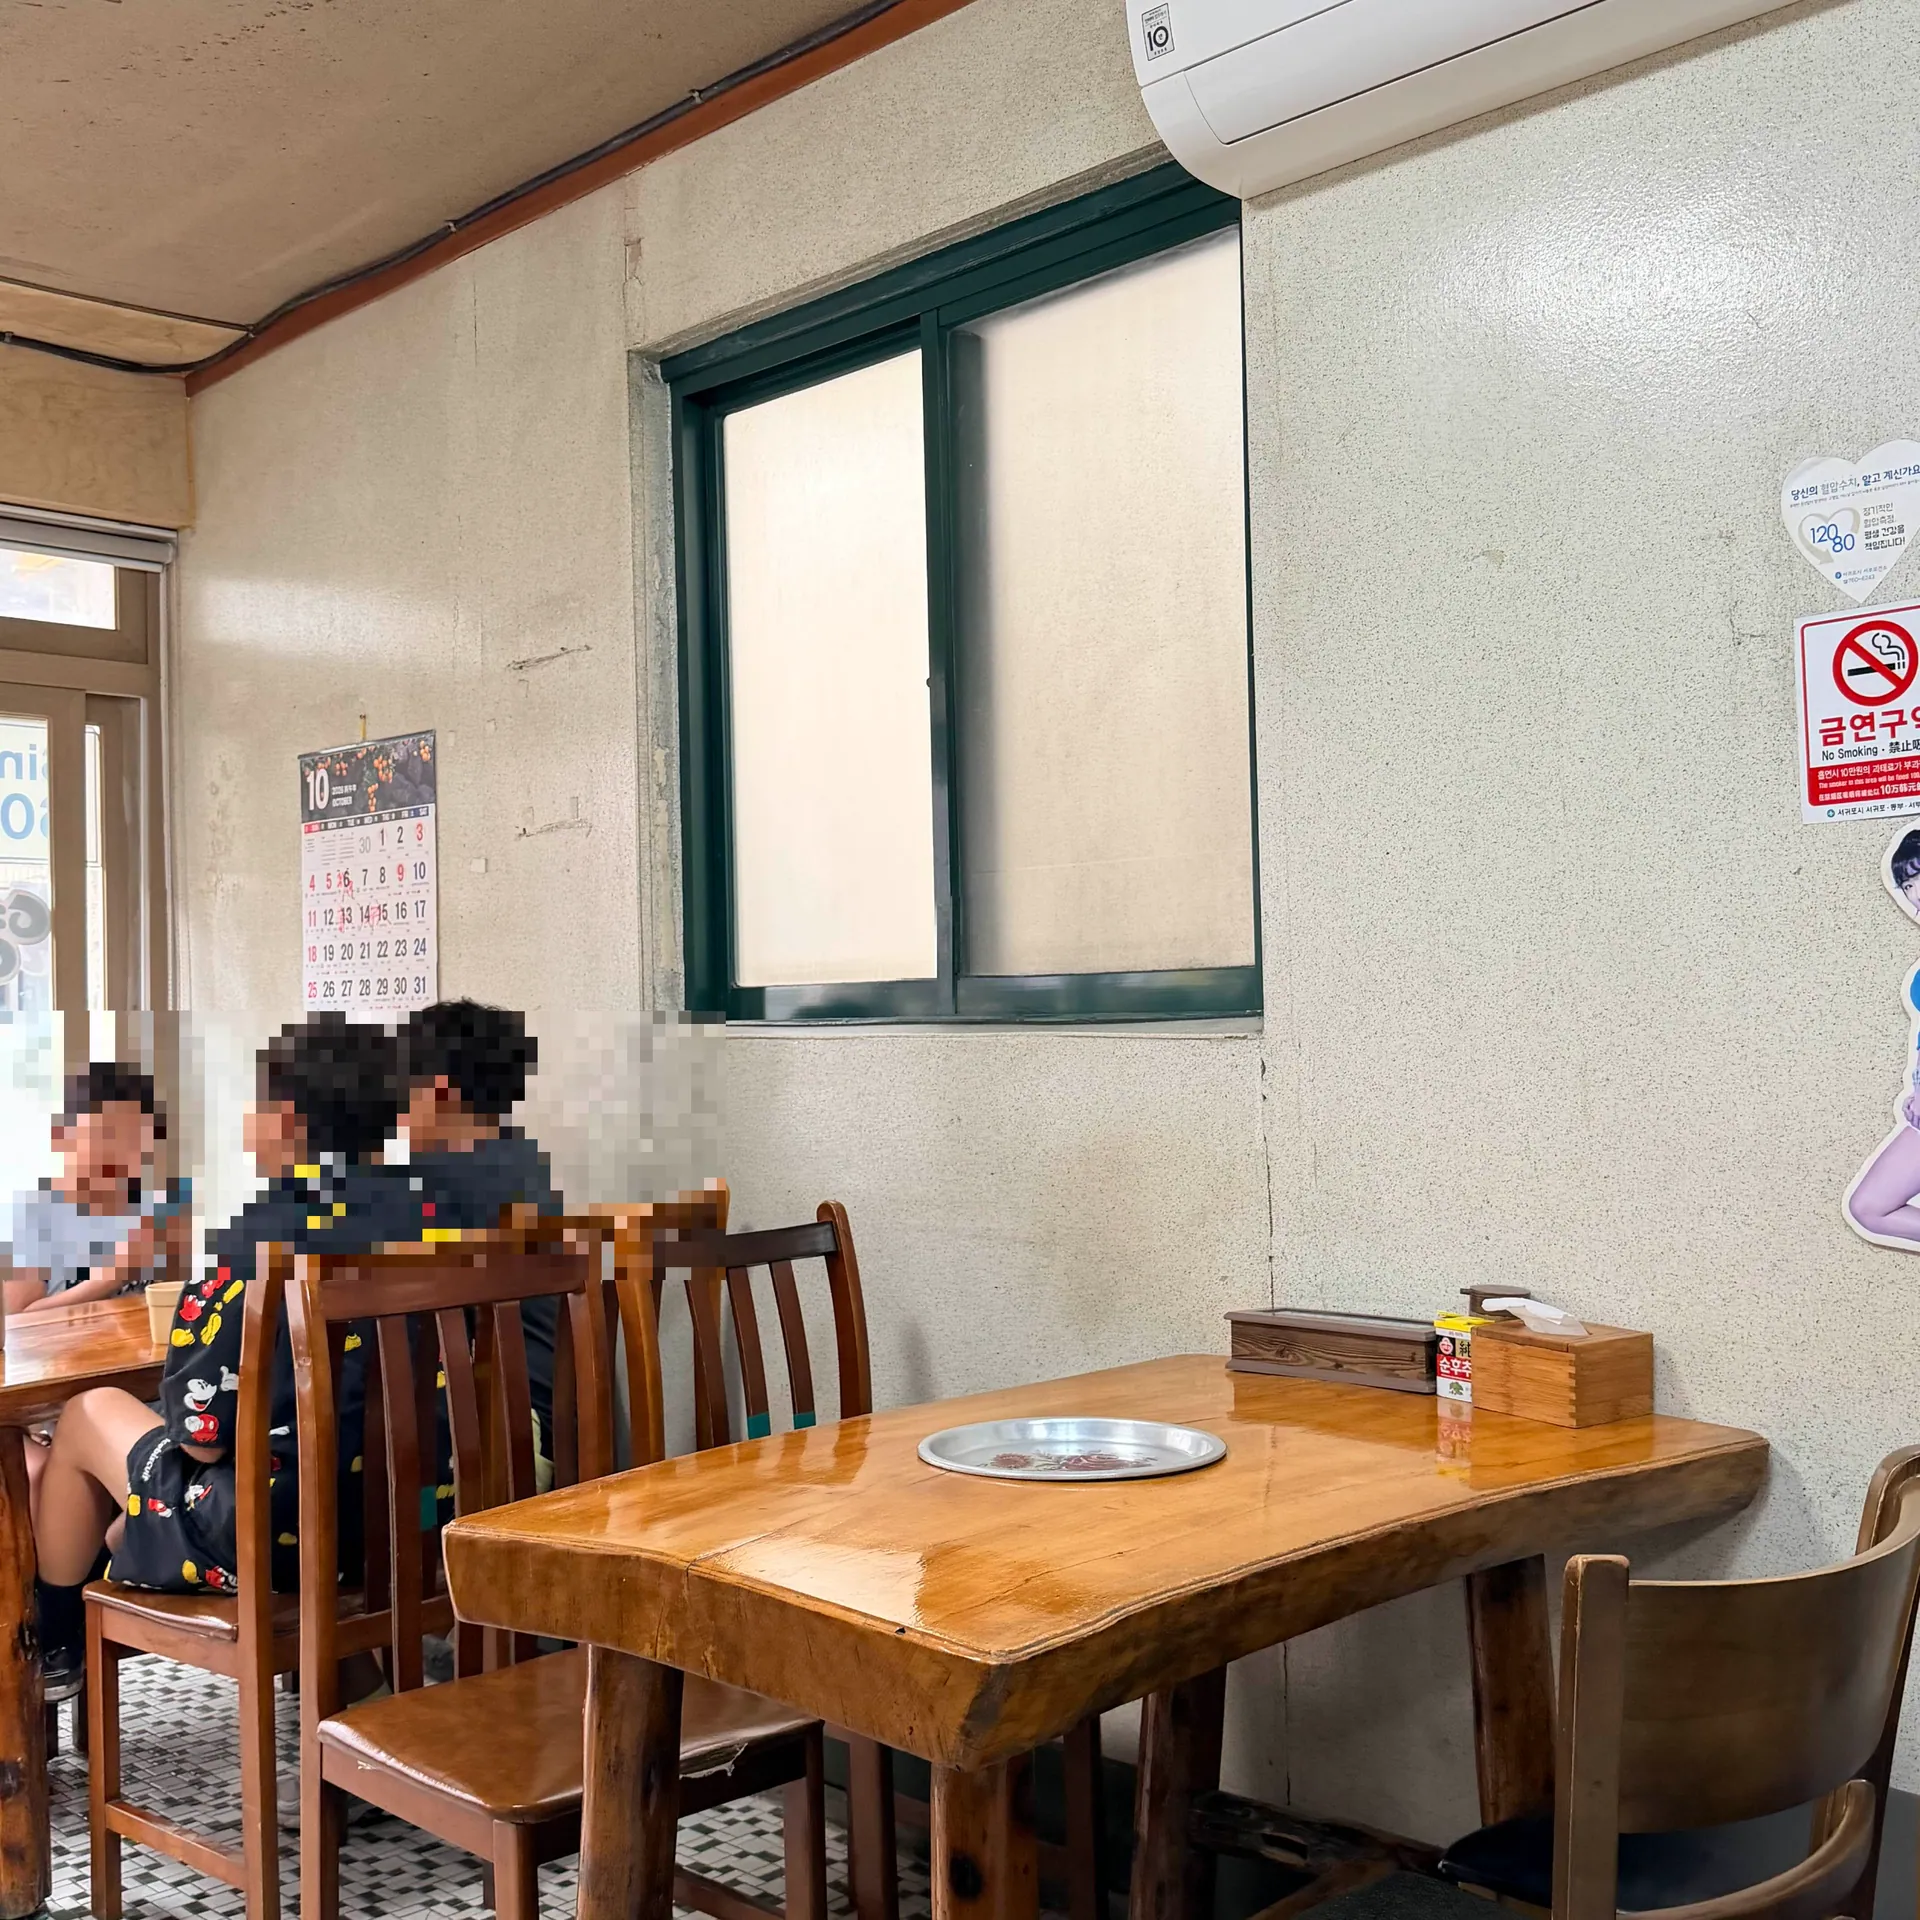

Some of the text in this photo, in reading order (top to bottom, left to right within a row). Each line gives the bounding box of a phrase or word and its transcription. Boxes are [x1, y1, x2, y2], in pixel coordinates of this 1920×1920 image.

[1791, 485, 1818, 501] 당신의
[1862, 474, 1881, 487] 알고
[1863, 503, 1894, 517] 정기적인
[1810, 523, 1838, 543] 120
[1881, 524, 1905, 537] 건강을
[1832, 533, 1855, 553] 80
[1822, 750, 1835, 761] No
[1838, 745, 1878, 759] Smoking
[1817, 768, 1839, 780] 흡연시
[1840, 765, 1870, 777] 10만원의
[1872, 761, 1902, 774] 과태료가
[307, 768, 330, 811] 10
[1837, 807, 1864, 816] 서귀포시
[359, 836, 371, 854] 30
[380, 828, 385, 846] 1
[397, 826, 404, 844] 2
[416, 823, 423, 841] 3
[309, 875, 315, 891] 4
[326, 873, 332, 889] 5
[343, 870, 350, 887] 6
[362, 869, 368, 886] 7
[379, 866, 386, 884] 8
[397, 864, 404, 881] 9
[413, 861, 426, 880] 10
[308, 910, 317, 927] 11
[324, 908, 334, 925] 12
[341, 907, 352, 924] 13
[360, 905, 370, 923] 14
[378, 903, 388, 921] 15
[395, 902, 407, 920] 16
[414, 900, 426, 918] 17
[308, 937, 426, 962] 18 19 20 21 22 23 24
[308, 976, 426, 998] 25 26 27 28 29 30 31
[1439, 1357, 1472, 1377] 순후추
